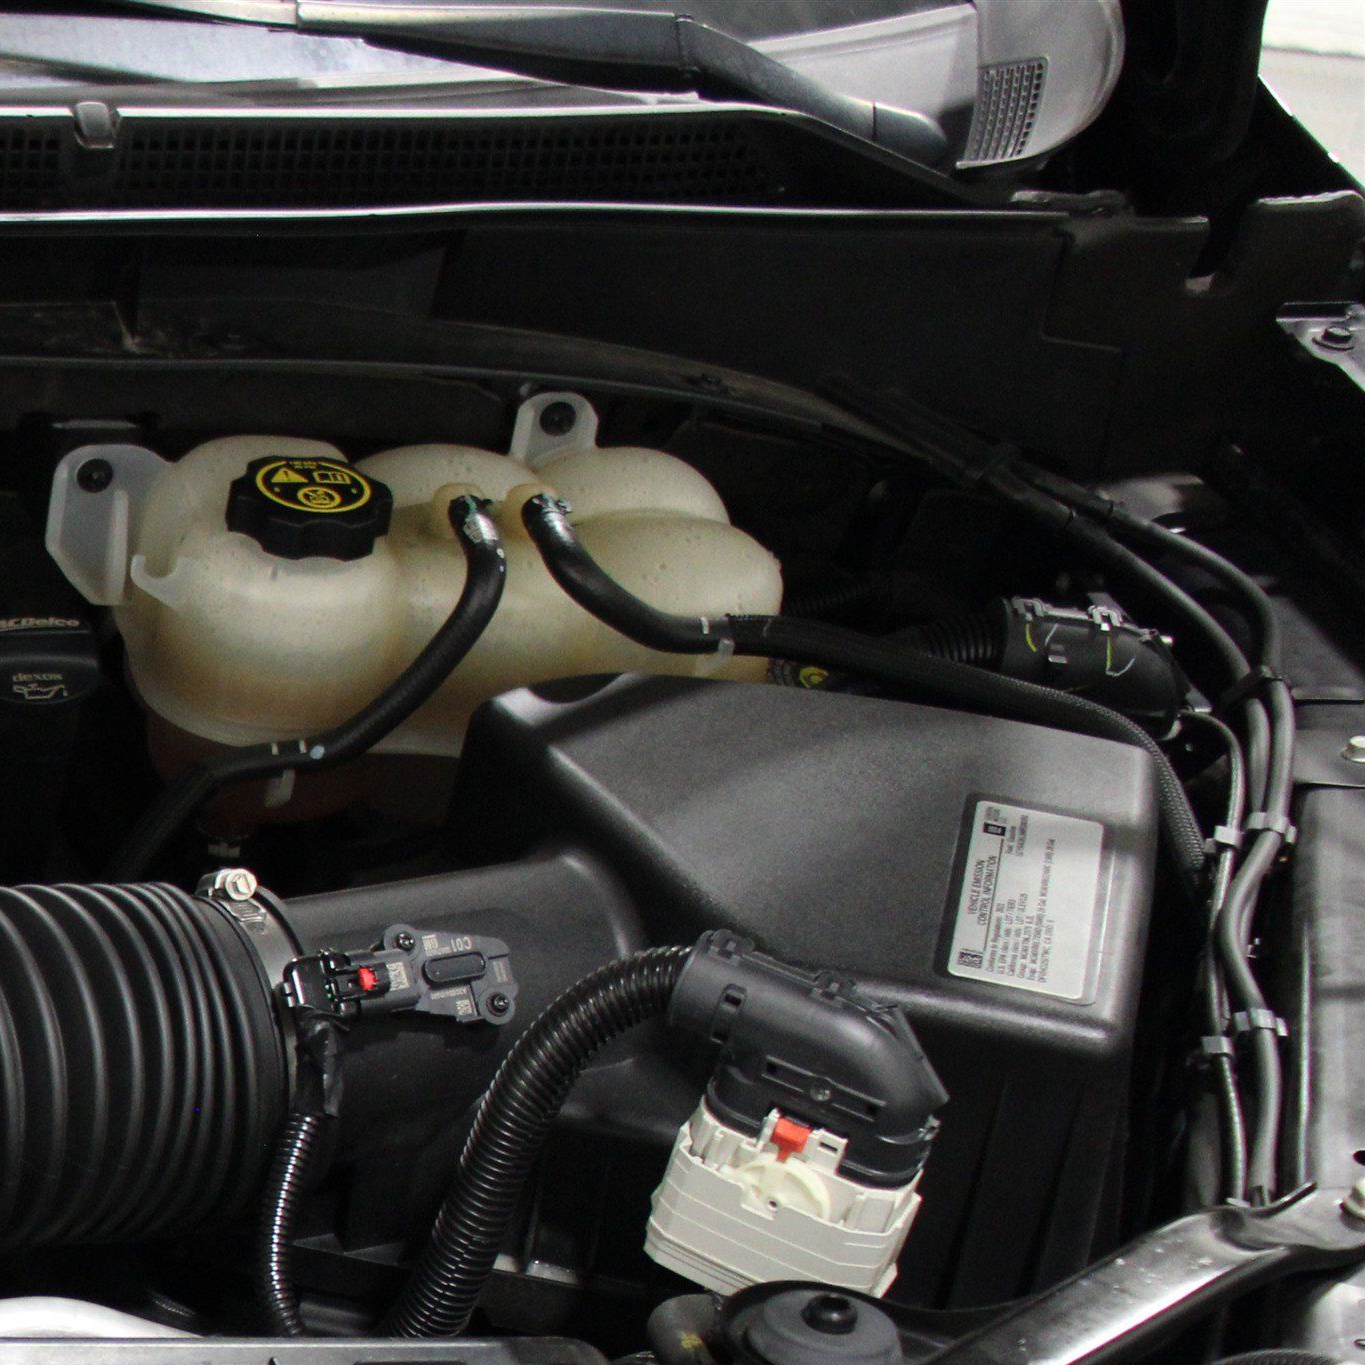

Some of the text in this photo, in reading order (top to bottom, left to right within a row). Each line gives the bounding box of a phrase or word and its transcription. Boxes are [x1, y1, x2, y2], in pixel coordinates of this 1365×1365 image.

[12, 673, 63, 682] dexos
[968, 860, 984, 914] VEHICLE EMISSION
[978, 855, 996, 925] CONTROL INFORMATION
